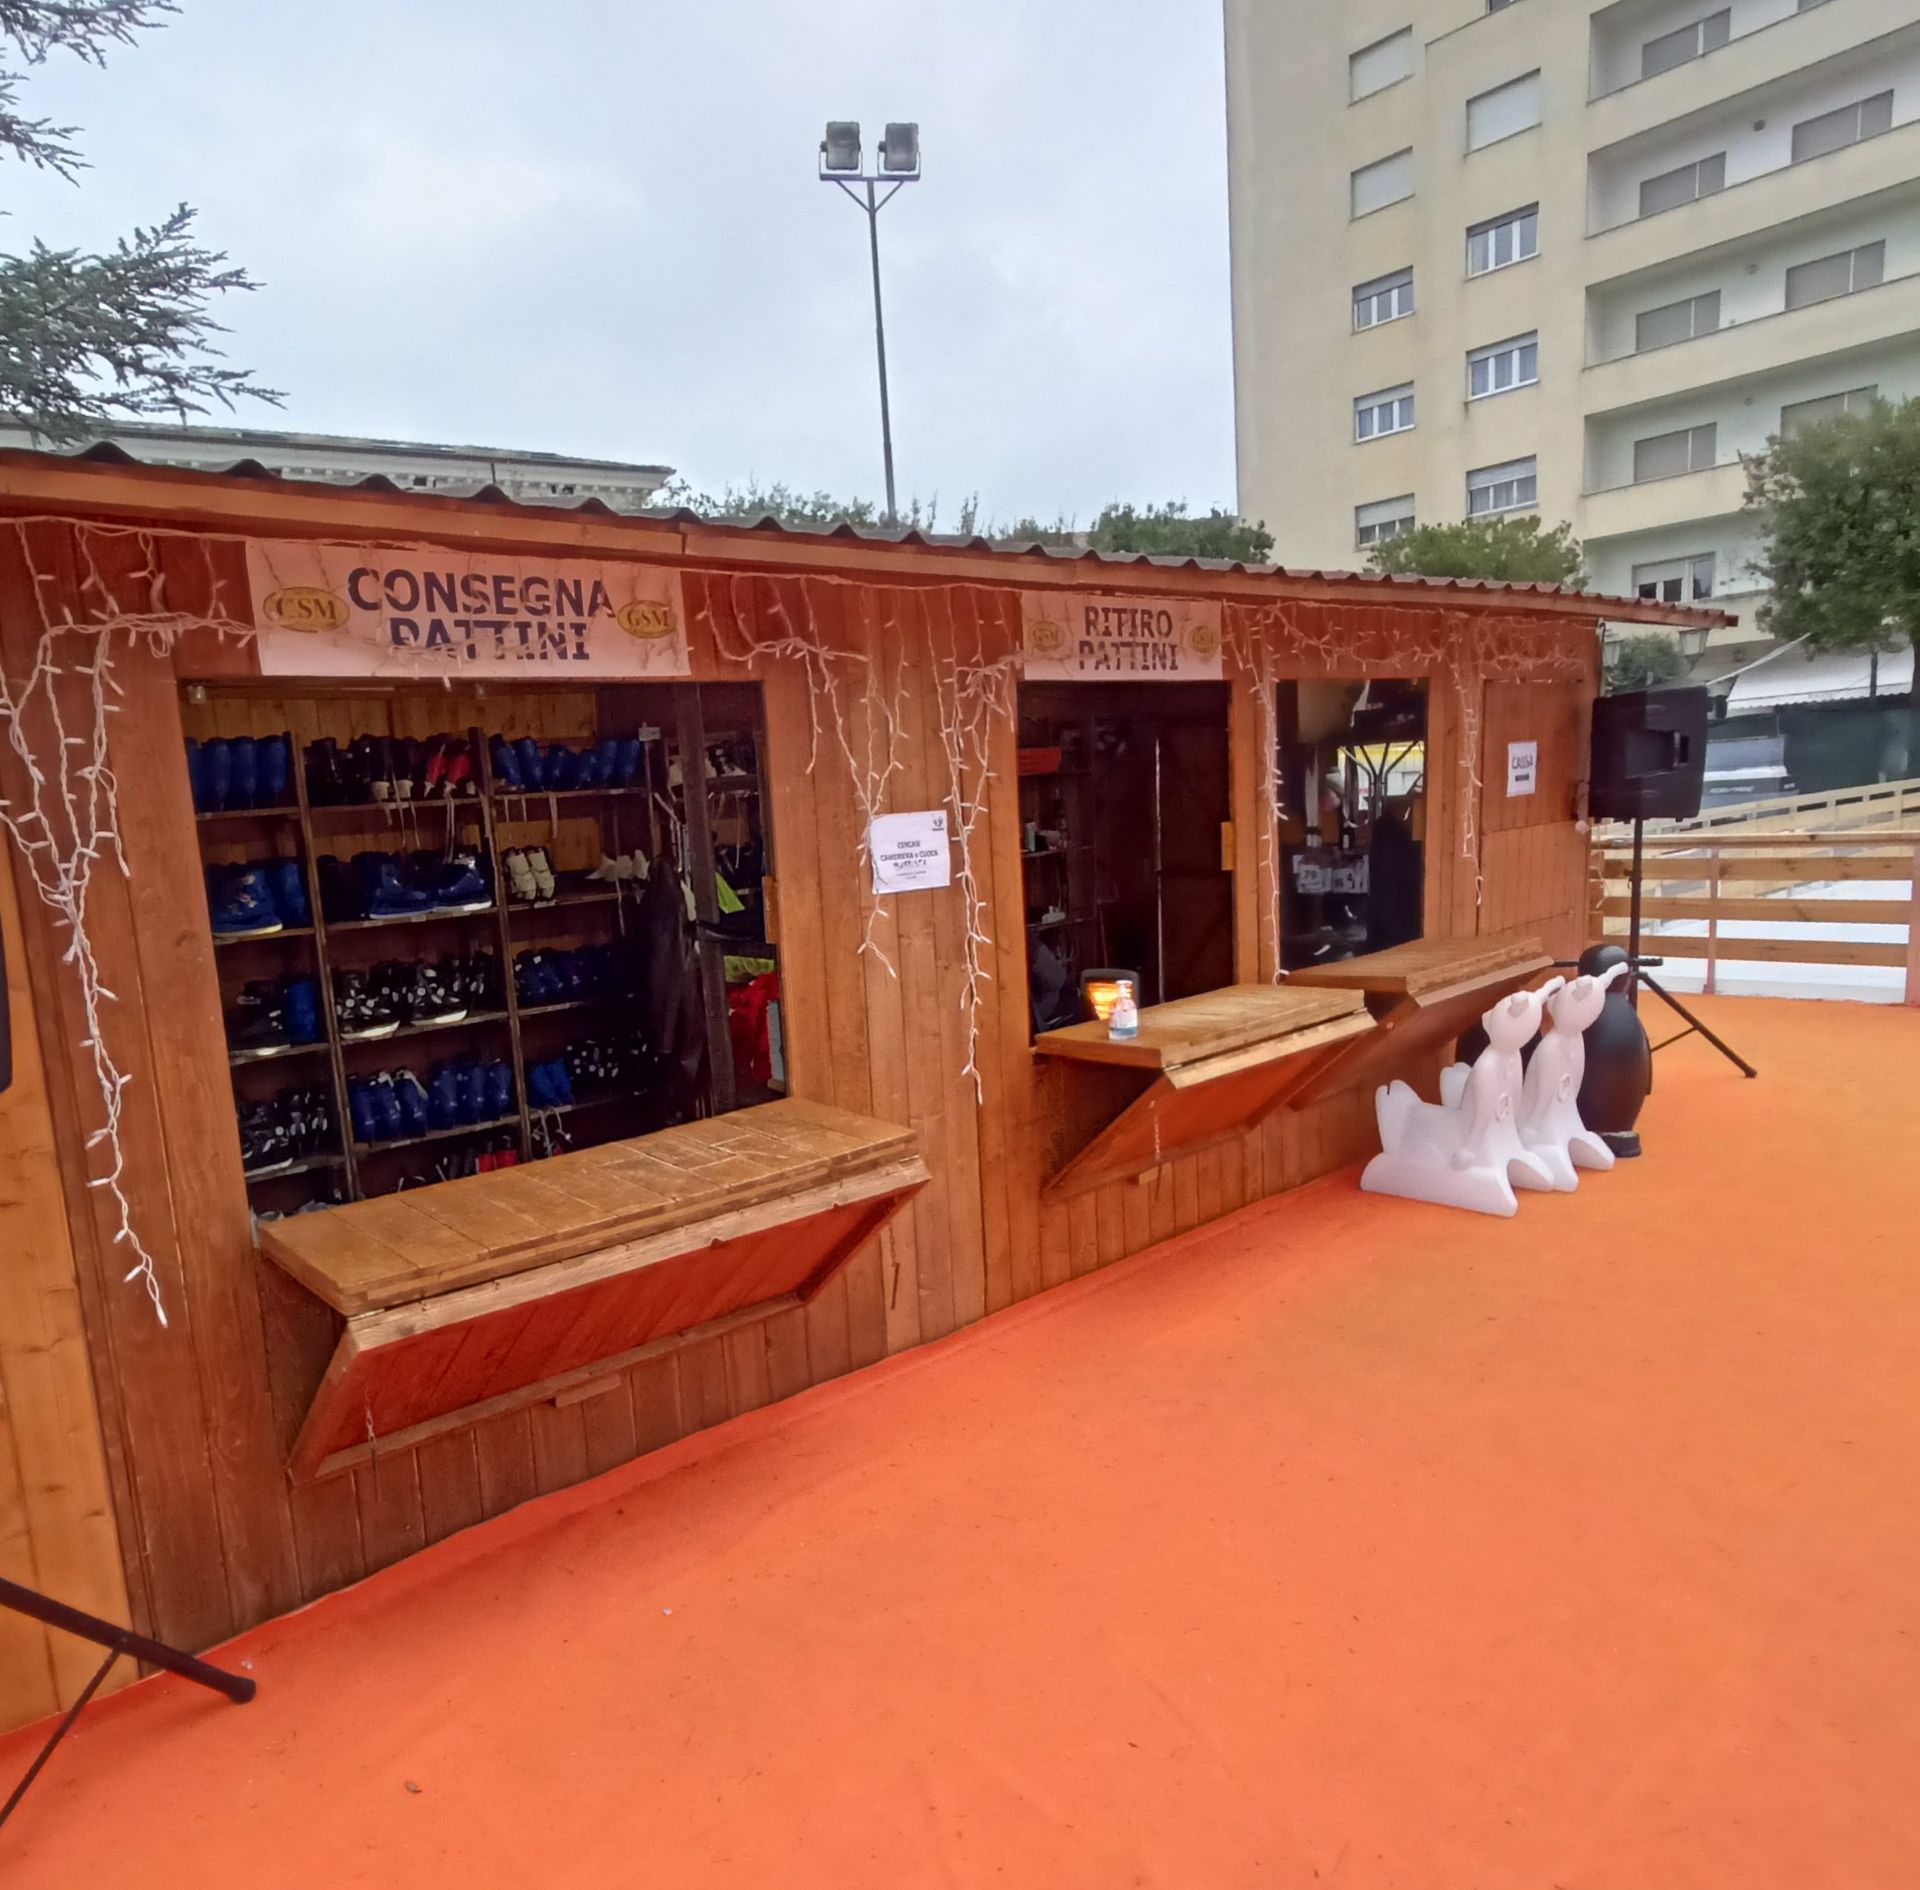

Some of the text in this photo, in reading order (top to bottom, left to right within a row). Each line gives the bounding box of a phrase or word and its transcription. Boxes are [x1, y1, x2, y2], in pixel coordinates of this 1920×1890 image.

[347, 567, 616, 618] CONSEGNA
[389, 617, 590, 660] PATTINI
[1084, 606, 1173, 638] RITIRO
[1079, 640, 1178, 671] PATTINI
